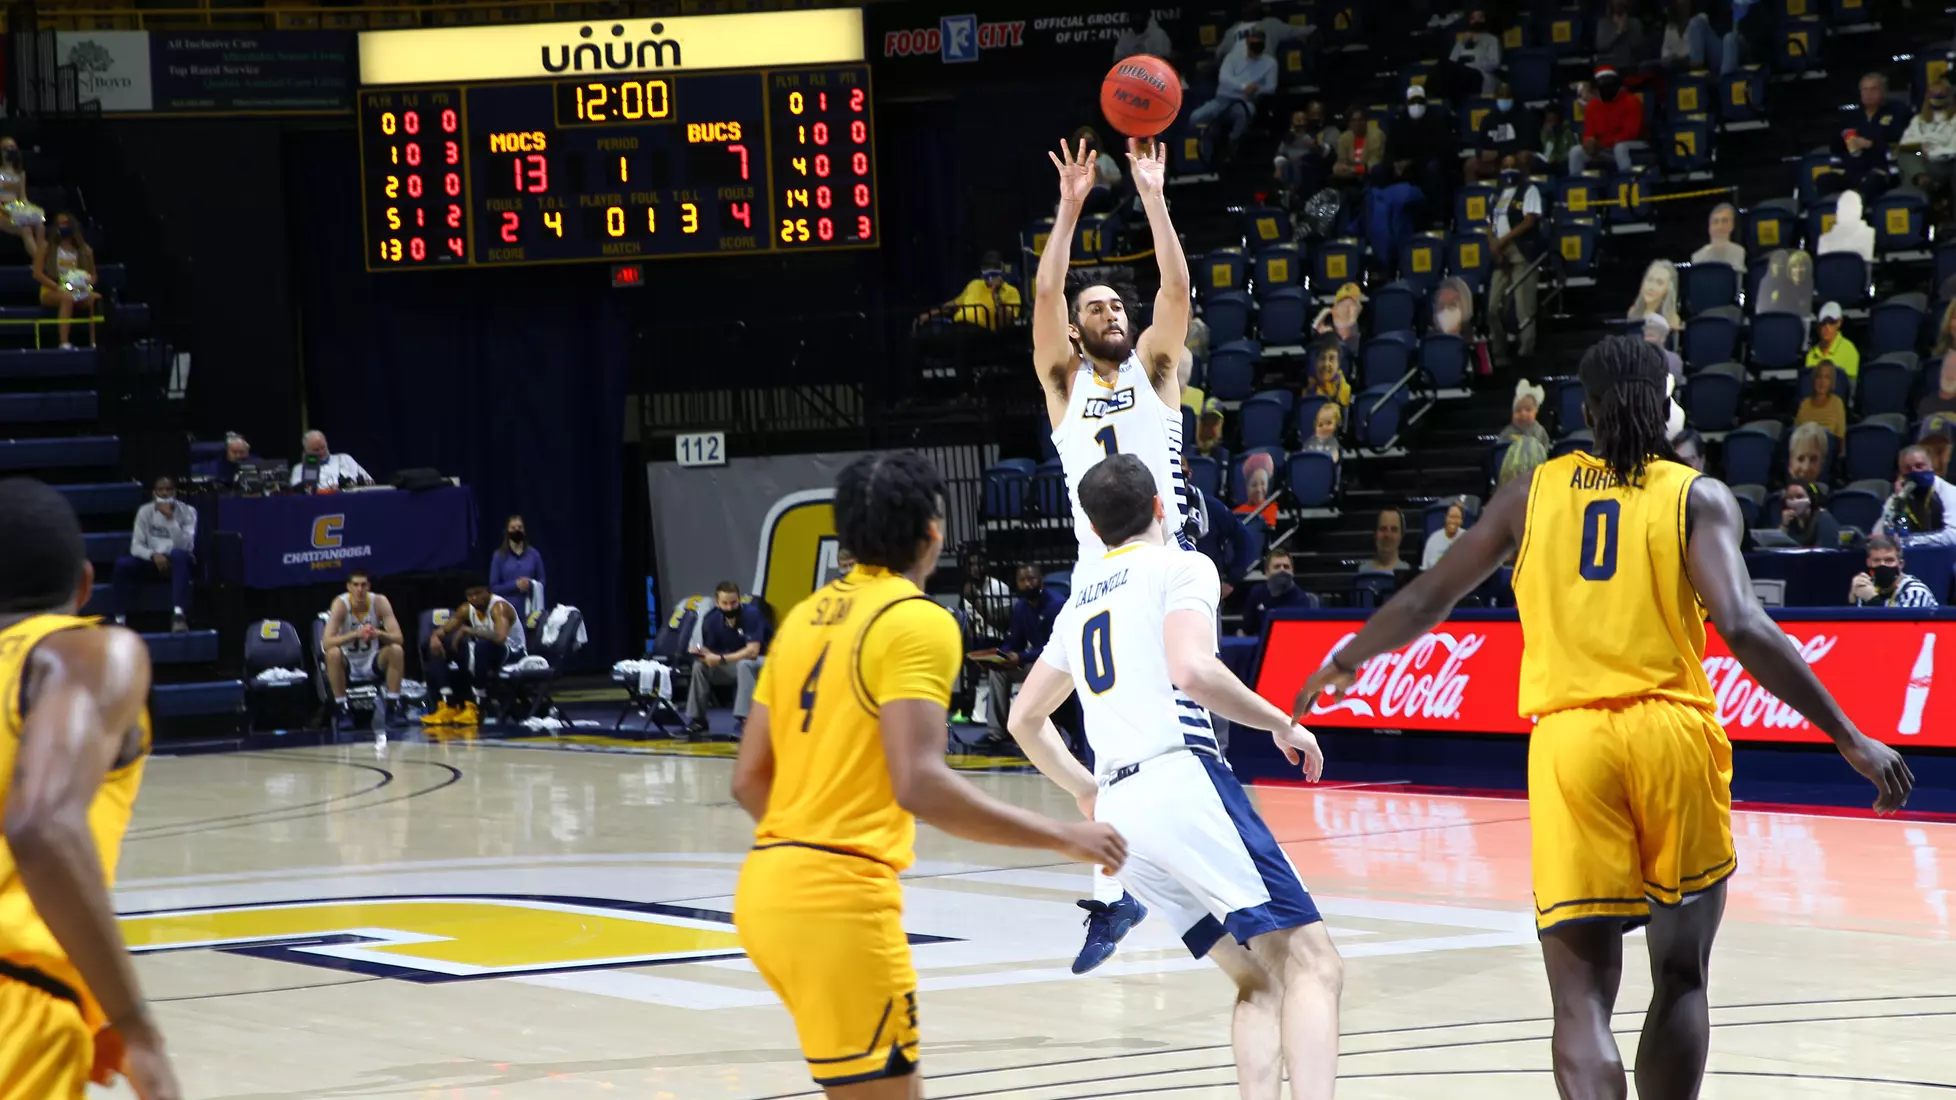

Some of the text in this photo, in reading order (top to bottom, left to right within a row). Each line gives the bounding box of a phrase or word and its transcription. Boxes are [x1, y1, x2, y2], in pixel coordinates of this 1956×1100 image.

[1033, 15, 1085, 30] OFFICIAL
[185, 40, 231, 49] Inclusive
[232, 39, 259, 49] Care
[541, 22, 682, 72] unum
[884, 28, 942, 57] FOOD
[978, 20, 1026, 49] CITY
[1055, 31, 1072, 44] OF
[168, 64, 261, 78] Top Rated Service
[1116, 64, 1167, 93] Wilson
[575, 79, 669, 122] 12:00
[788, 87, 865, 116] 0 1 2
[381, 108, 458, 136] 0 0 0
[686, 120, 743, 144] BUCS
[798, 118, 868, 146] 1 0 0
[390, 140, 459, 167] 1 0 3
[489, 130, 547, 154] MOCS
[597, 136, 638, 151] PERIOD
[513, 153, 549, 194] 13
[619, 155, 628, 183] 1
[726, 143, 750, 181] 7
[791, 151, 869, 178] 4 0 0
[384, 172, 461, 199] 2 0 0
[580, 191, 660, 206] PLAYER FOUL
[718, 186, 754, 200] FOULS
[785, 182, 870, 210] 14 0 0
[385, 203, 463, 231] 5 1 2
[486, 198, 523, 211] FOULS
[680, 201, 699, 234] 3
[730, 200, 751, 229] 4
[500, 210, 520, 243] 2
[543, 210, 563, 239] 4
[606, 205, 656, 238] 0 1
[780, 214, 872, 243] 25 0 3
[380, 236, 464, 262] 13 0 4
[488, 247, 525, 261] SCORE
[602, 242, 641, 255] MATCH
[719, 237, 756, 250] SCORE
[681, 435, 719, 462] 112
[1579, 498, 1621, 581] 0
[282, 545, 372, 564] CHATTANOOGA
[1075, 568, 1129, 608] CALDWELL
[1082, 609, 1116, 696] 0
[799, 640, 832, 733] 4
